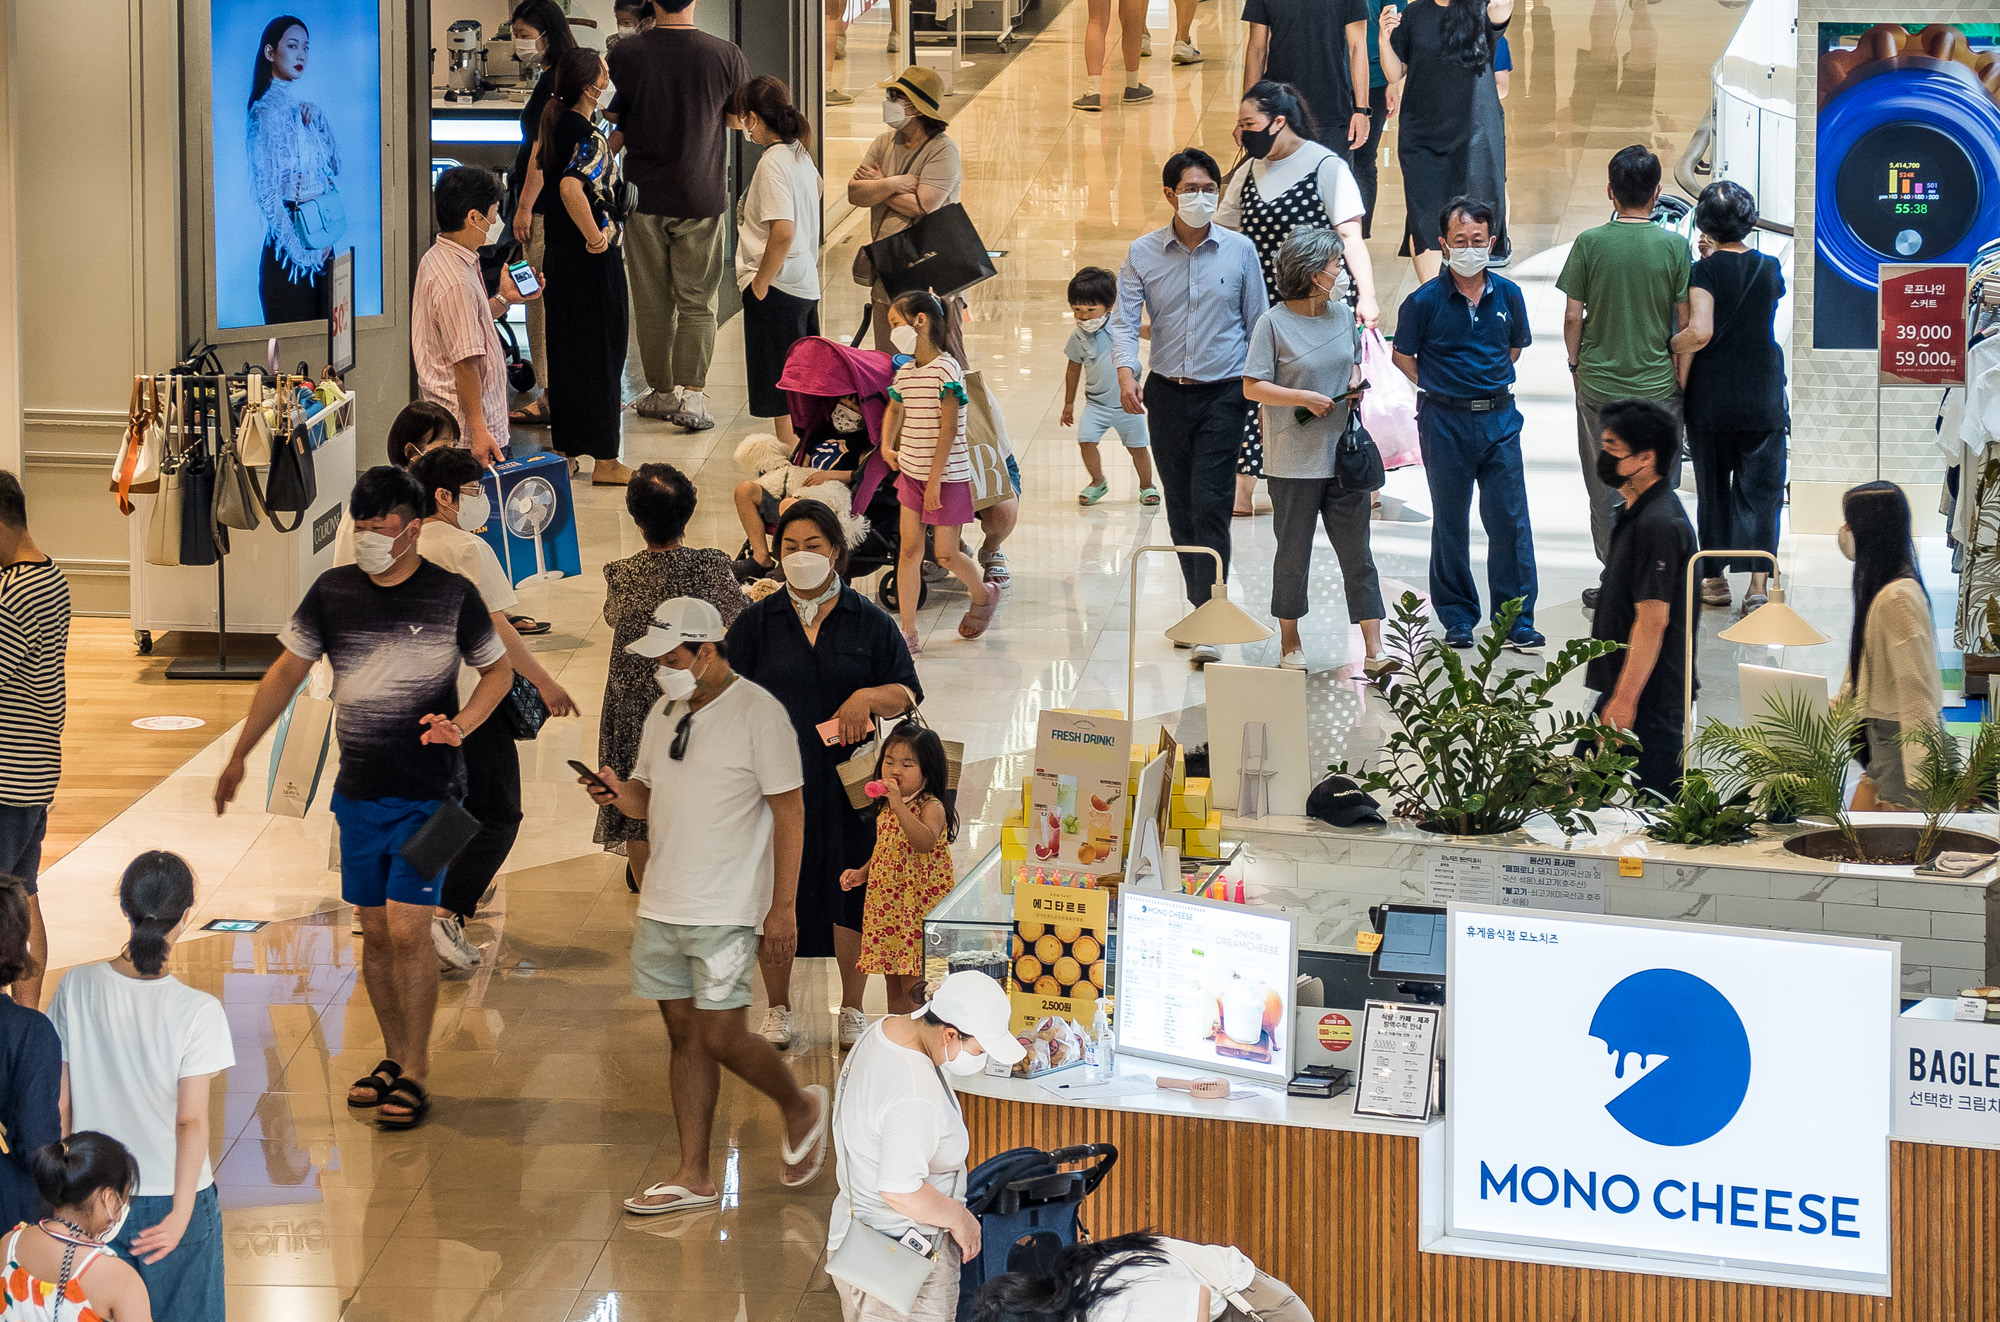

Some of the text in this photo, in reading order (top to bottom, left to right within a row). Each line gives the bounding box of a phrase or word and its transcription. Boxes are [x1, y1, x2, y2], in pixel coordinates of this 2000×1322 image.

[1895, 203, 1928, 214] 55:38
[1903, 284, 1946, 295] 로프나인
[1910, 299, 1938, 308] 스커트
[1896, 325, 1952, 341] 39,000
[1051, 729, 1115, 747] FRESH DRINK!
[1529, 856, 1576, 868] 원산지 표시판
[1502, 874, 1516, 884] 국산
[1593, 871, 1601, 880] 외
[1502, 897, 1509, 905] 산
[1586, 893, 1601, 901] 호주
[1032, 898, 1087, 914] 에그타르트
[1148, 907, 1193, 921] MONO CHEESE
[1233, 928, 1262, 940] ONION
[1466, 925, 1559, 945] 휴게음식점 모노치즈
[1041, 1000, 1072, 1013] 2,500원
[1409, 1023, 1422, 1031] 안내
[1909, 1047, 2000, 1089] BAGLE
[1909, 1090, 1954, 1109] 선택한
[1480, 1160, 1861, 1239] MONO CHEESE
